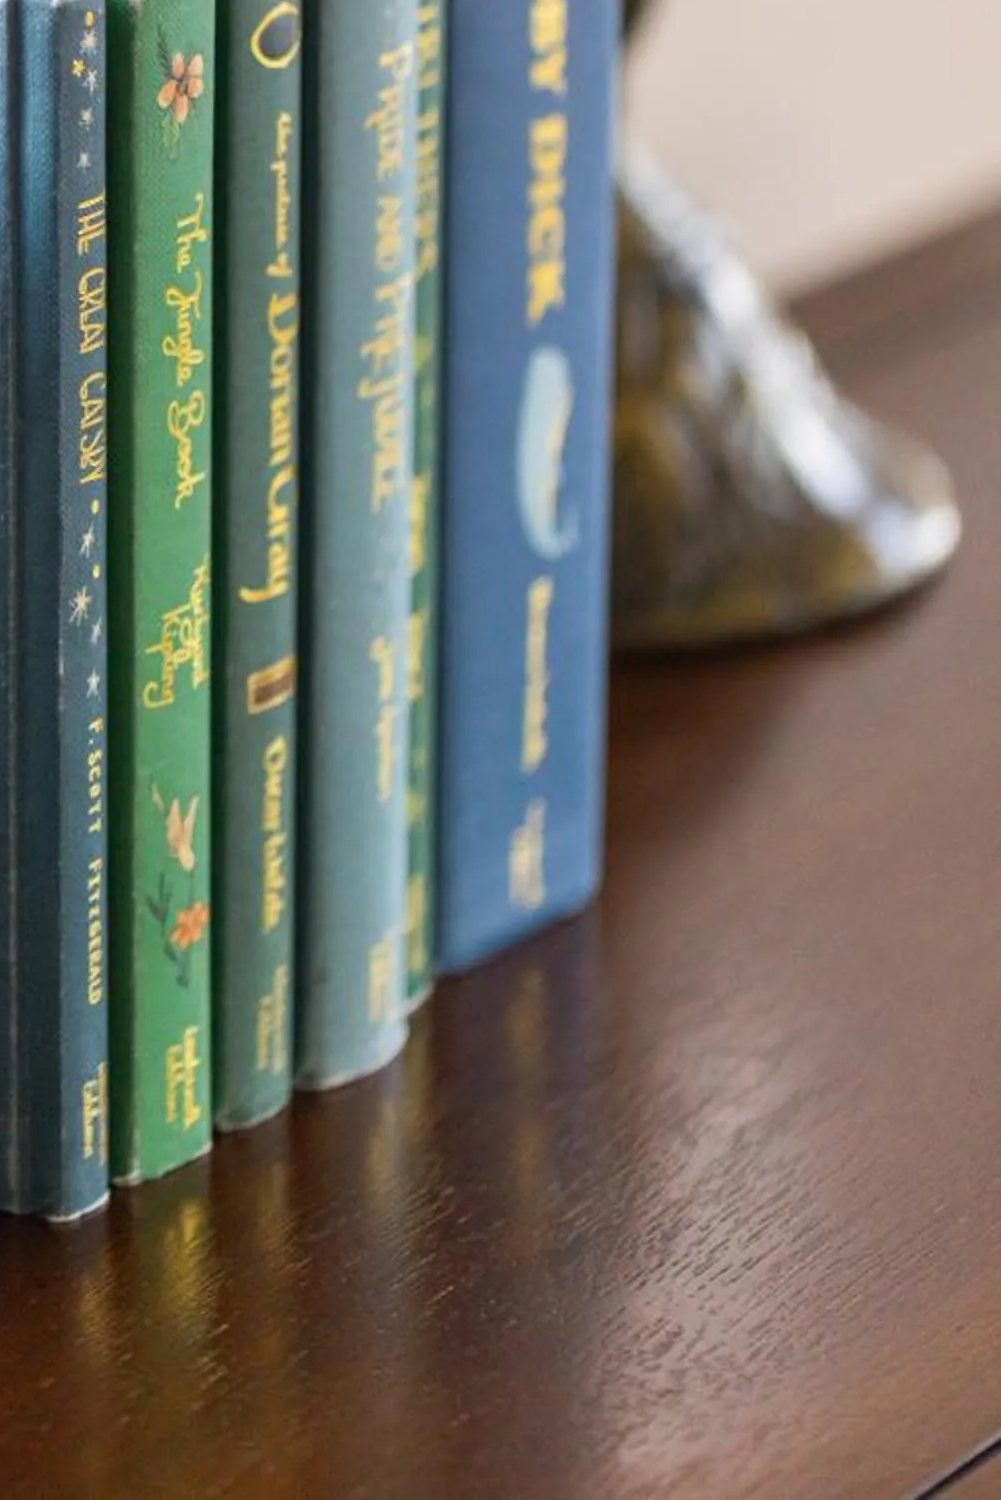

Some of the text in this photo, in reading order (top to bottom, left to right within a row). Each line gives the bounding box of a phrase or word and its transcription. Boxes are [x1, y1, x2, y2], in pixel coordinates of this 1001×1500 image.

[76, 189, 107, 256] THE
[525, 113, 568, 327] DICK
[162, 192, 207, 509] The Jungle Book
[86, 856, 104, 1006] FITZGERALD
